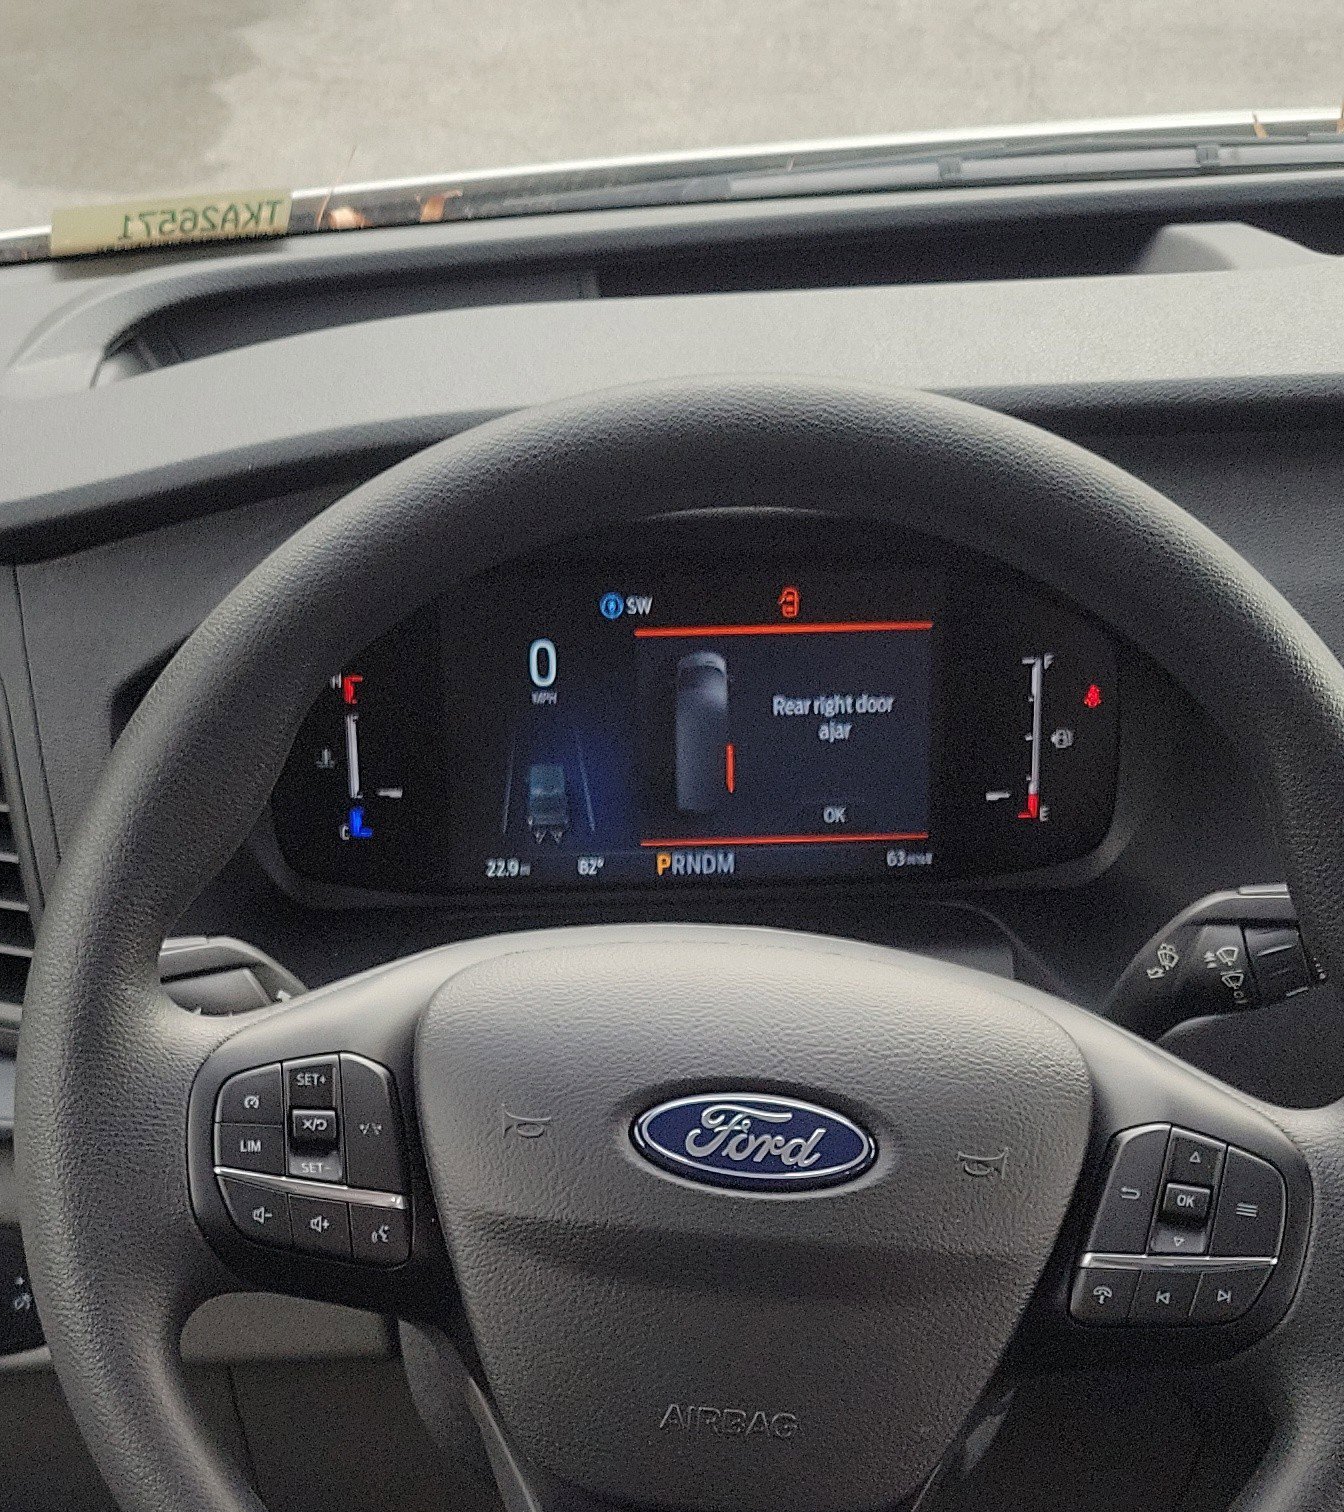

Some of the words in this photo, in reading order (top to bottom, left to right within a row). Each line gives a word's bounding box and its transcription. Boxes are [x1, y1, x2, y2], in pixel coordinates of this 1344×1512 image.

[529, 637, 557, 688] 0
[772, 694, 811, 716] Rear
[813, 694, 854, 718] right
[856, 693, 895, 714] door
[818, 720, 852, 743] ajar
[823, 805, 846, 824] OK
[239, 1139, 262, 1153] LIM
[684, 1103, 828, 1168] Ford
[1176, 1193, 1195, 1208] OK
[659, 1403, 798, 1438] AIRBAG
